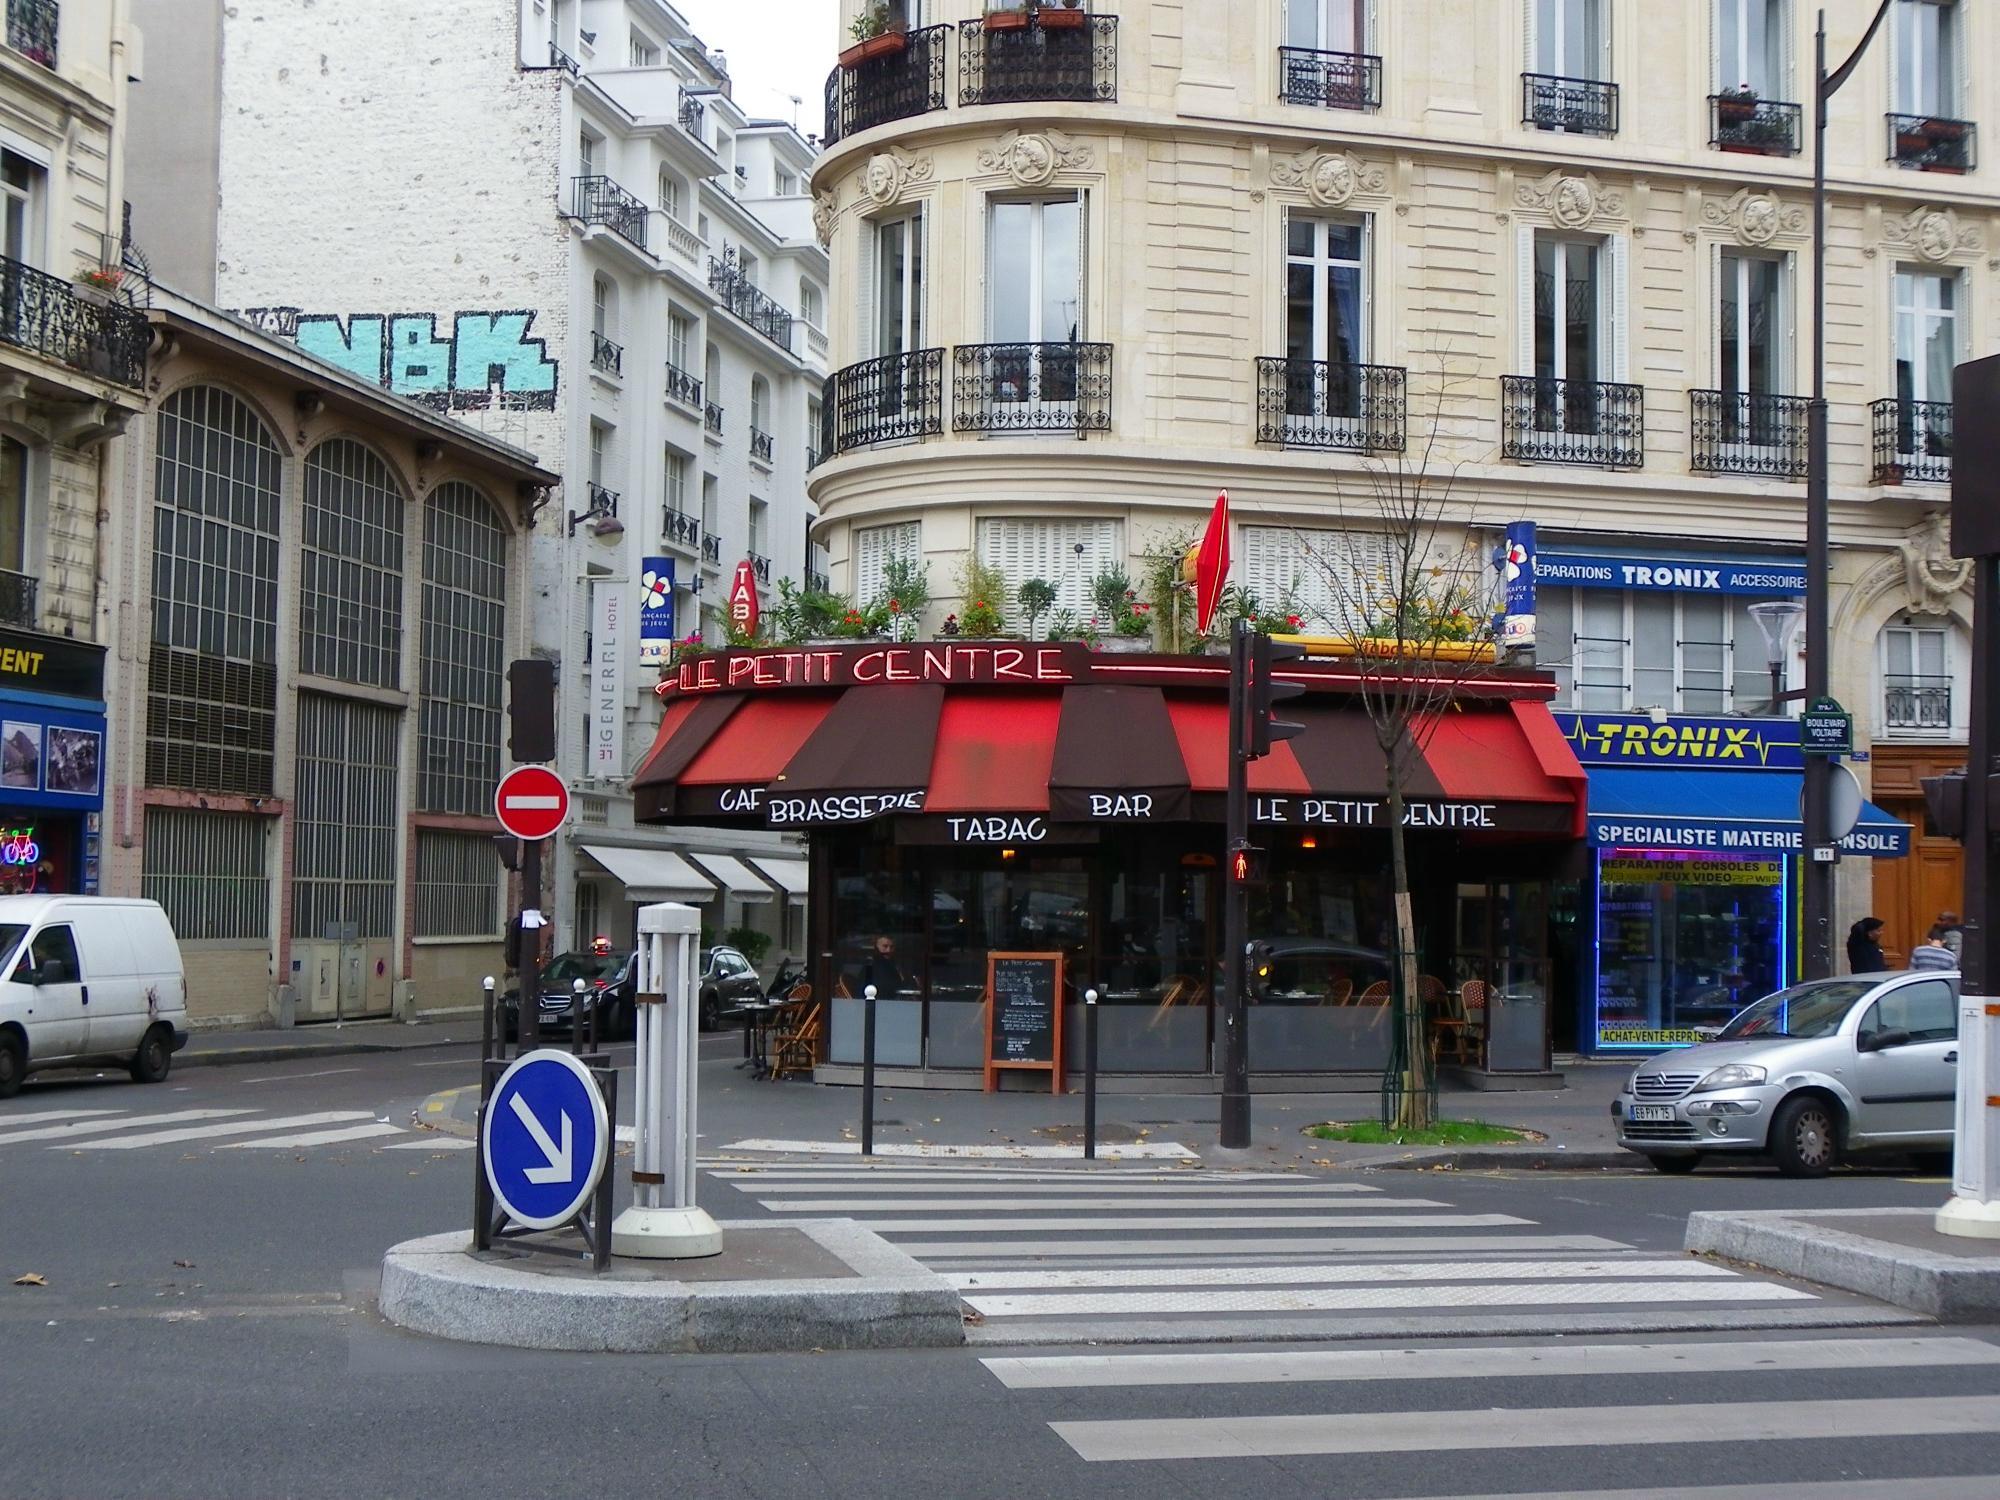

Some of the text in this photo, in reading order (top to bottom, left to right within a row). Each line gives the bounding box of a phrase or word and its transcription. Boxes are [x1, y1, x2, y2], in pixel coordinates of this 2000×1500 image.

[1535, 564, 1612, 580] EPARATIONS
[1622, 565, 1721, 589] TRONIX
[607, 596, 617, 630] HOTEL
[733, 567, 751, 637] TABA
[0, 647, 44, 676] ENT
[679, 644, 1073, 691] LE PETIT CENTRE
[1806, 718, 1847, 727] BOULEVARD
[1811, 728, 1843, 738] VOLTAIRE
[1596, 723, 1751, 760] TRONIX
[719, 788, 1153, 842] CAF BRASSERIE TABAC BAR
[1256, 797, 1288, 821] LE
[1302, 800, 1380, 825] PETIT
[1597, 825, 1900, 851] SPECIALISTE MATERIE NSOLE
[1602, 859, 1684, 870] REPARATION
[1692, 862, 1760, 872] CONSOLES
[1819, 850, 1829, 859] 11
[1656, 872, 1693, 882] JEUX
[1694, 873, 1732, 882] VIDEO
[1603, 1030, 1702, 1042] ACHAT-VENTE-REPRIS
[1660, 1107, 1670, 1119] 75
